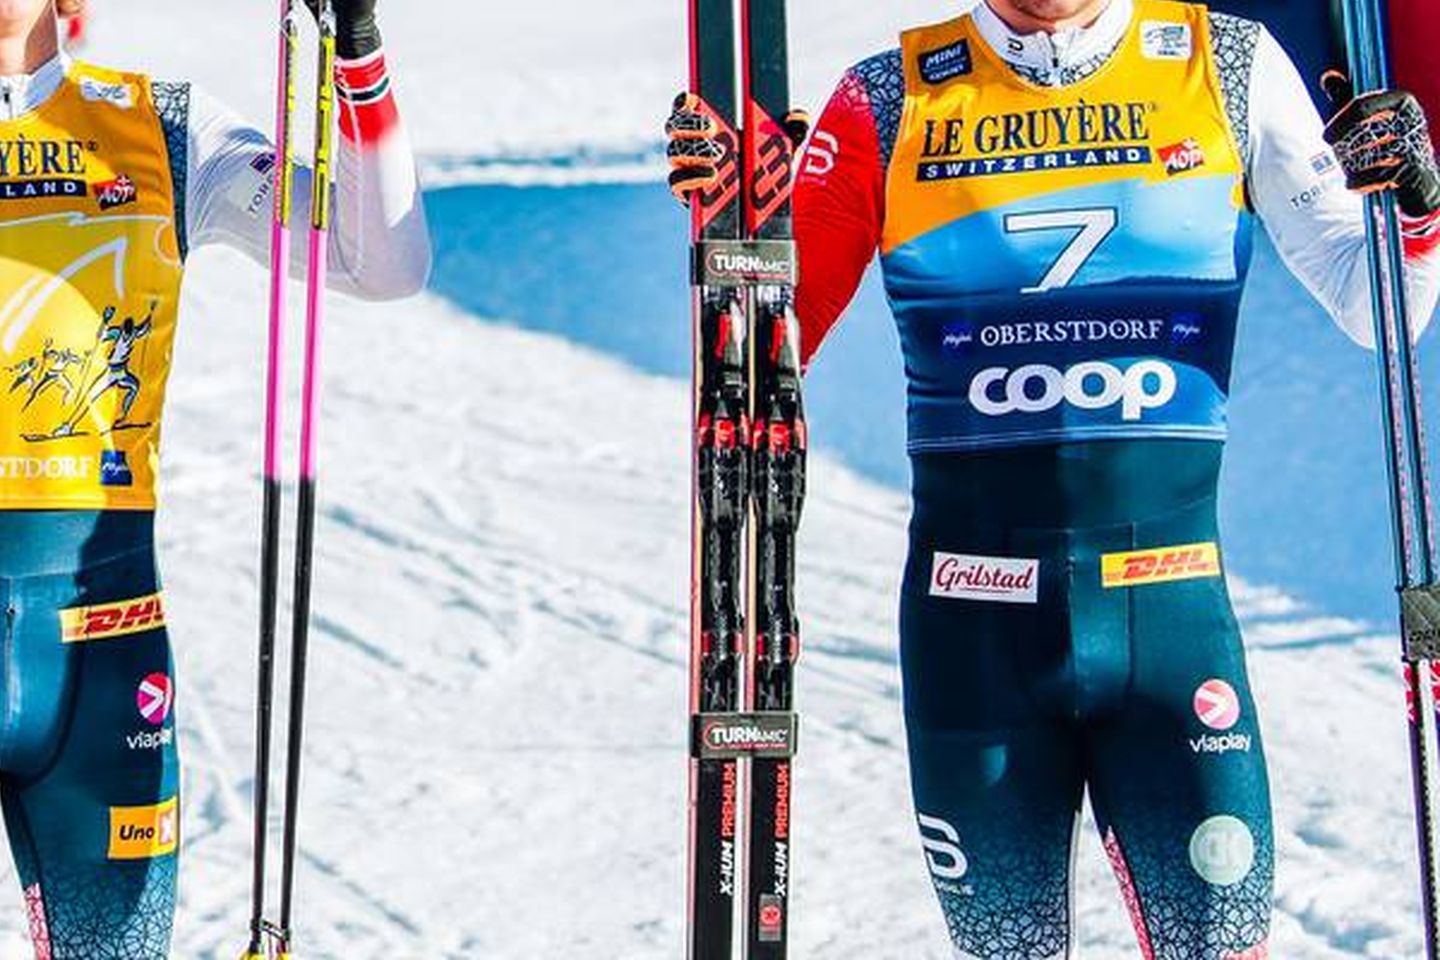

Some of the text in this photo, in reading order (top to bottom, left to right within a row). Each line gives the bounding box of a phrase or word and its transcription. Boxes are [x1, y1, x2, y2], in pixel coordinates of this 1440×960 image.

[922, 98, 1151, 158] LE GRUYÈRE
[926, 149, 1142, 178] SWITZERLAND
[1003, 206, 1118, 294] 7
[980, 319, 1164, 347] OBERSTDORF
[968, 360, 1178, 421] coop
[936, 558, 1035, 591] Grilstad
[1123, 550, 1207, 580] DHL
[1189, 732, 1252, 754] viaplay
[119, 824, 155, 841] Uno
[720, 762, 736, 897] X-IUM PREMIUM
[774, 764, 790, 898] X-IUM PREMIUM
